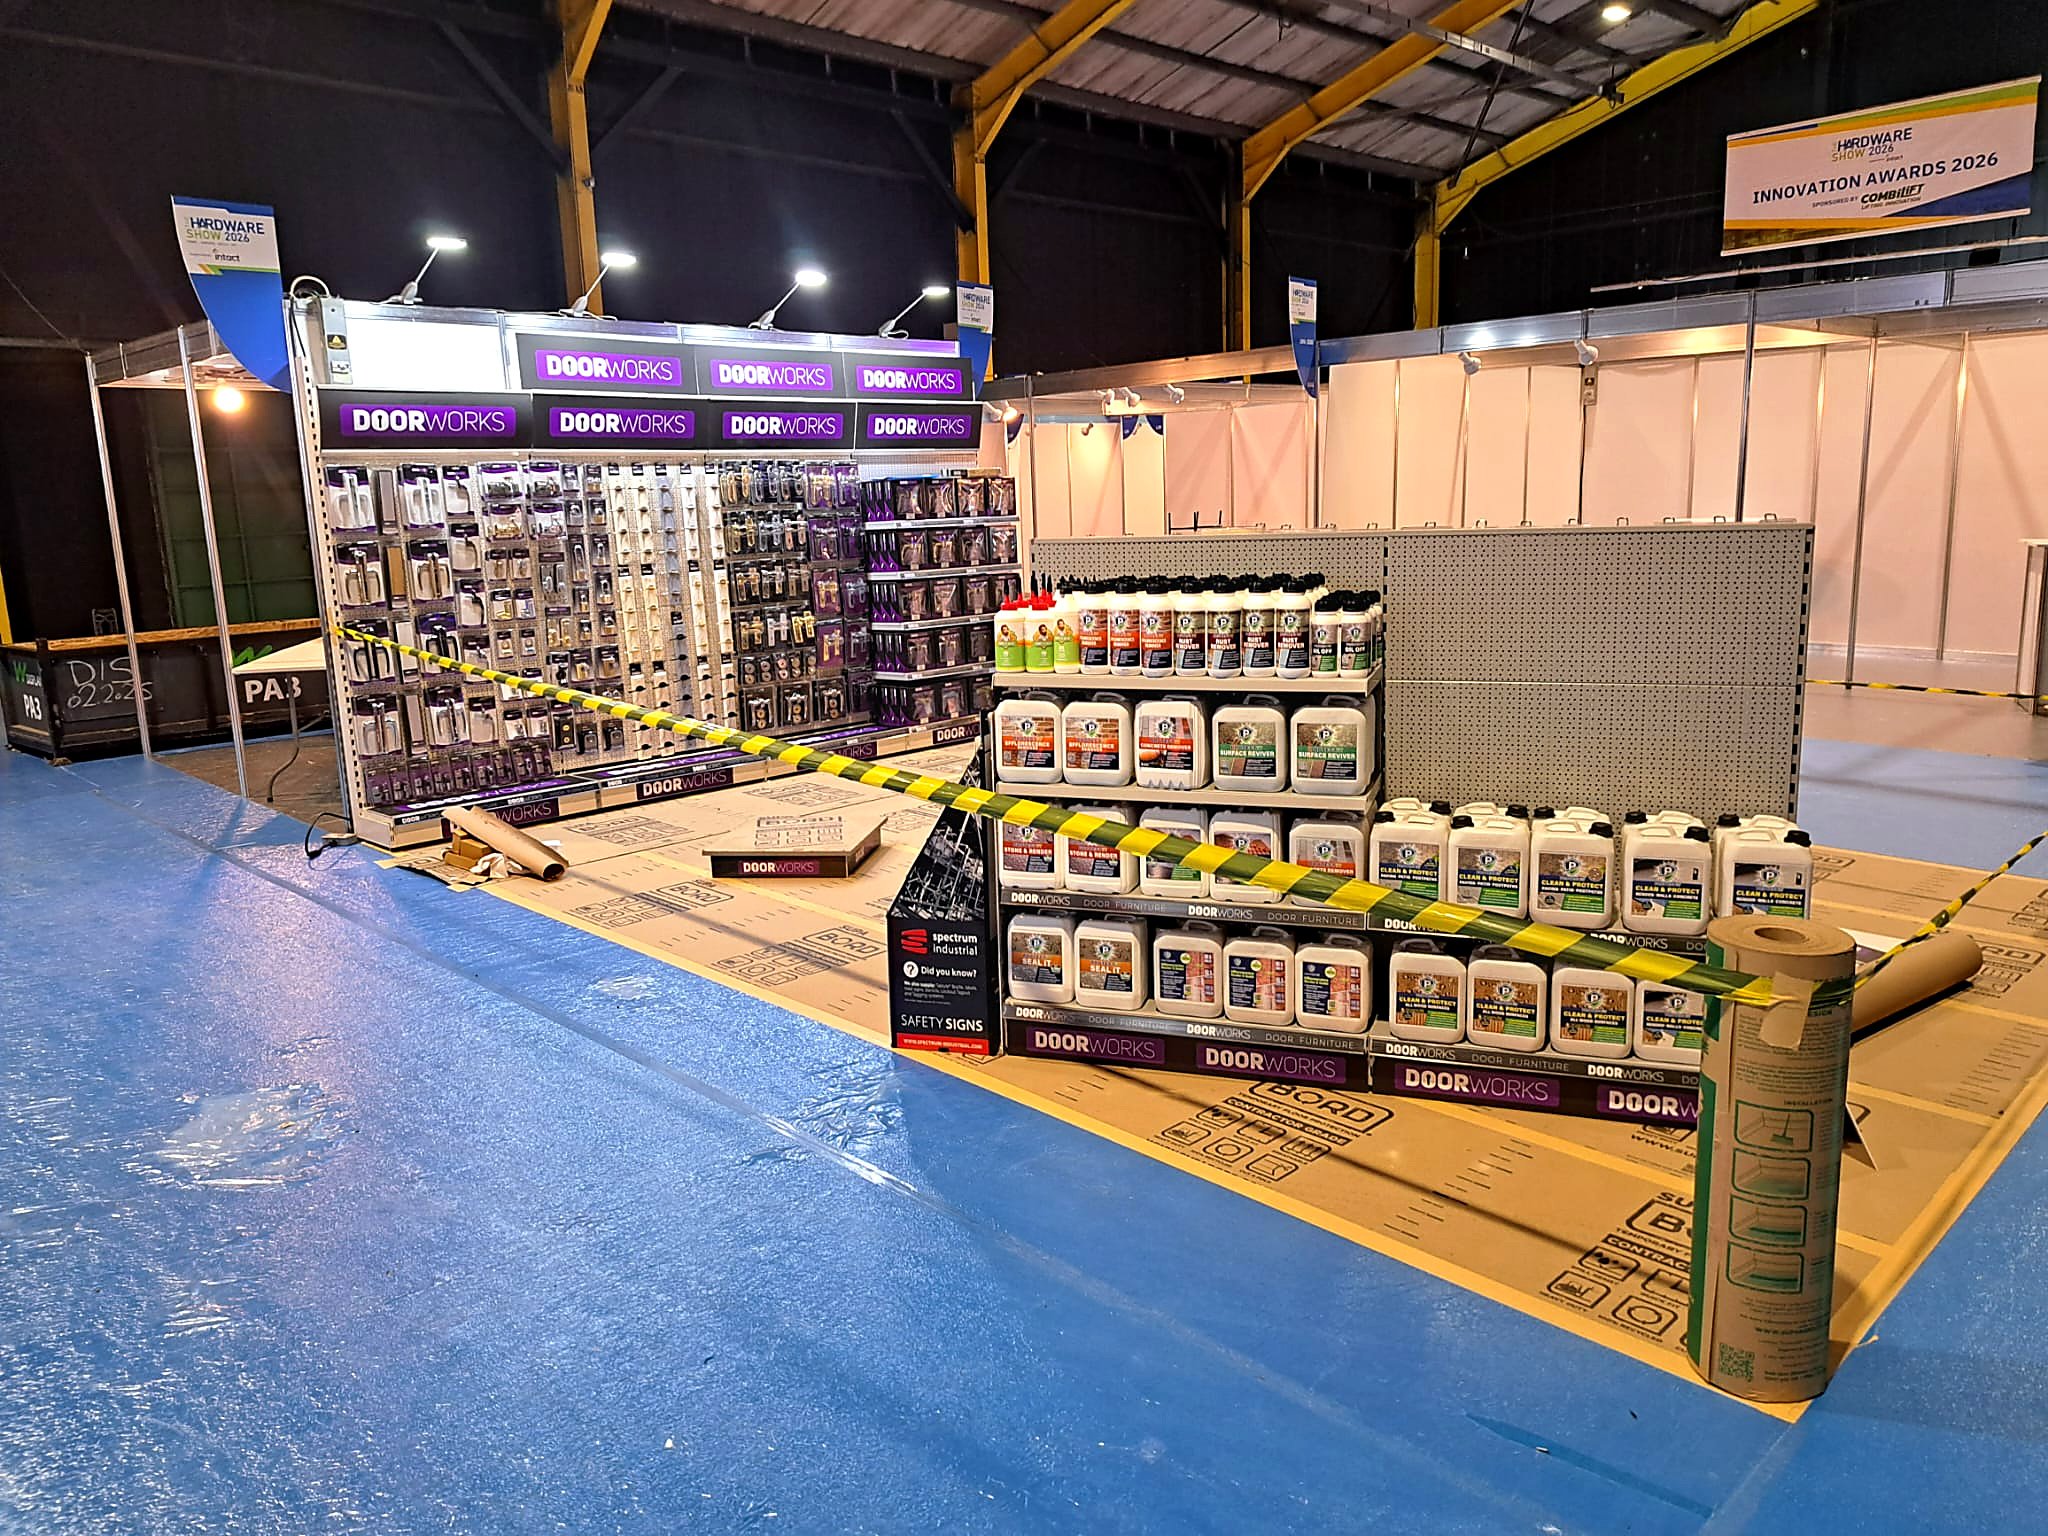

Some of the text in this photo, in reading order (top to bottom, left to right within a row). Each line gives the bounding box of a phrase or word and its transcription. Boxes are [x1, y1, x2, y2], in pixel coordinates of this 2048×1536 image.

[1837, 128, 1913, 151] HARDWARE
[1831, 143, 1894, 162] SHOW 2026
[1752, 152, 1999, 204] INNOVATION AWARDS 2026
[1812, 198, 1849, 208] SPONSORED
[186, 229, 250, 243] SHOW 2026
[190, 217, 265, 235] HARDWARE
[215, 254, 240, 262] intact
[546, 354, 673, 381] DOORWORKS
[719, 364, 826, 387] DOORWORKS
[864, 370, 956, 390] DOORWORKS
[352, 409, 505, 433] DOORWORKS
[560, 412, 685, 434] DOORWORKS
[731, 416, 836, 435] DOORWORKS
[874, 418, 965, 435] DOORWORKS
[244, 676, 302, 704] PA3
[24, 694, 42, 720] PA3
[937, 723, 980, 742] DOORWO
[643, 769, 728, 797] DOORWORKS
[498, 801, 552, 823] WORKS
[743, 861, 814, 874] DOORWORKS
[669, 881, 723, 903] BORD
[1572, 881, 1603, 889] PROTECT
[1667, 887, 1699, 895] PROTECT
[1011, 892, 1166, 913] DOORWORKS DOOR FURNITURE
[1769, 892, 1803, 900] PROTECT
[1188, 905, 1359, 926] DOORWORKS DOOR FURNITURE
[816, 932, 880, 954] BORD
[932, 933, 978, 944] spectrum
[1686, 941, 1707, 950] DO
[933, 945, 978, 956] industrial
[920, 965, 977, 978] Did you know?
[1022, 958, 1042, 966] SEAL
[1090, 964, 1121, 974] SEAL IT
[1015, 1007, 1075, 1021] DOORWORKS
[1088, 1015, 1115, 1025] DOOR
[1505, 1005, 1535, 1014] PROTECT
[1594, 1013, 1625, 1021] PROTECT
[901, 1014, 984, 1032] SAFETY SIGNS
[1035, 1031, 1156, 1059] DOORWORKS
[1186, 1024, 1354, 1048] DOORWORKS DOOR FURNITURE
[1205, 1047, 1336, 1078] DOORWORKS
[1385, 1043, 1569, 1071] DOORWORKS DOOR FURNITURE
[1587, 1064, 1699, 1084] DOORWORKS DO
[1405, 1068, 1549, 1101] DOORWORKS
[1266, 1083, 1375, 1122] BORD
[1608, 1090, 1699, 1119] DOORW
[1227, 1099, 1348, 1144] CONTRACTOR GRADE
[1657, 1192, 1694, 1207] SU
[1616, 1227, 1683, 1253] TEMPORARY
[1607, 1237, 1689, 1271] CONTRAC
